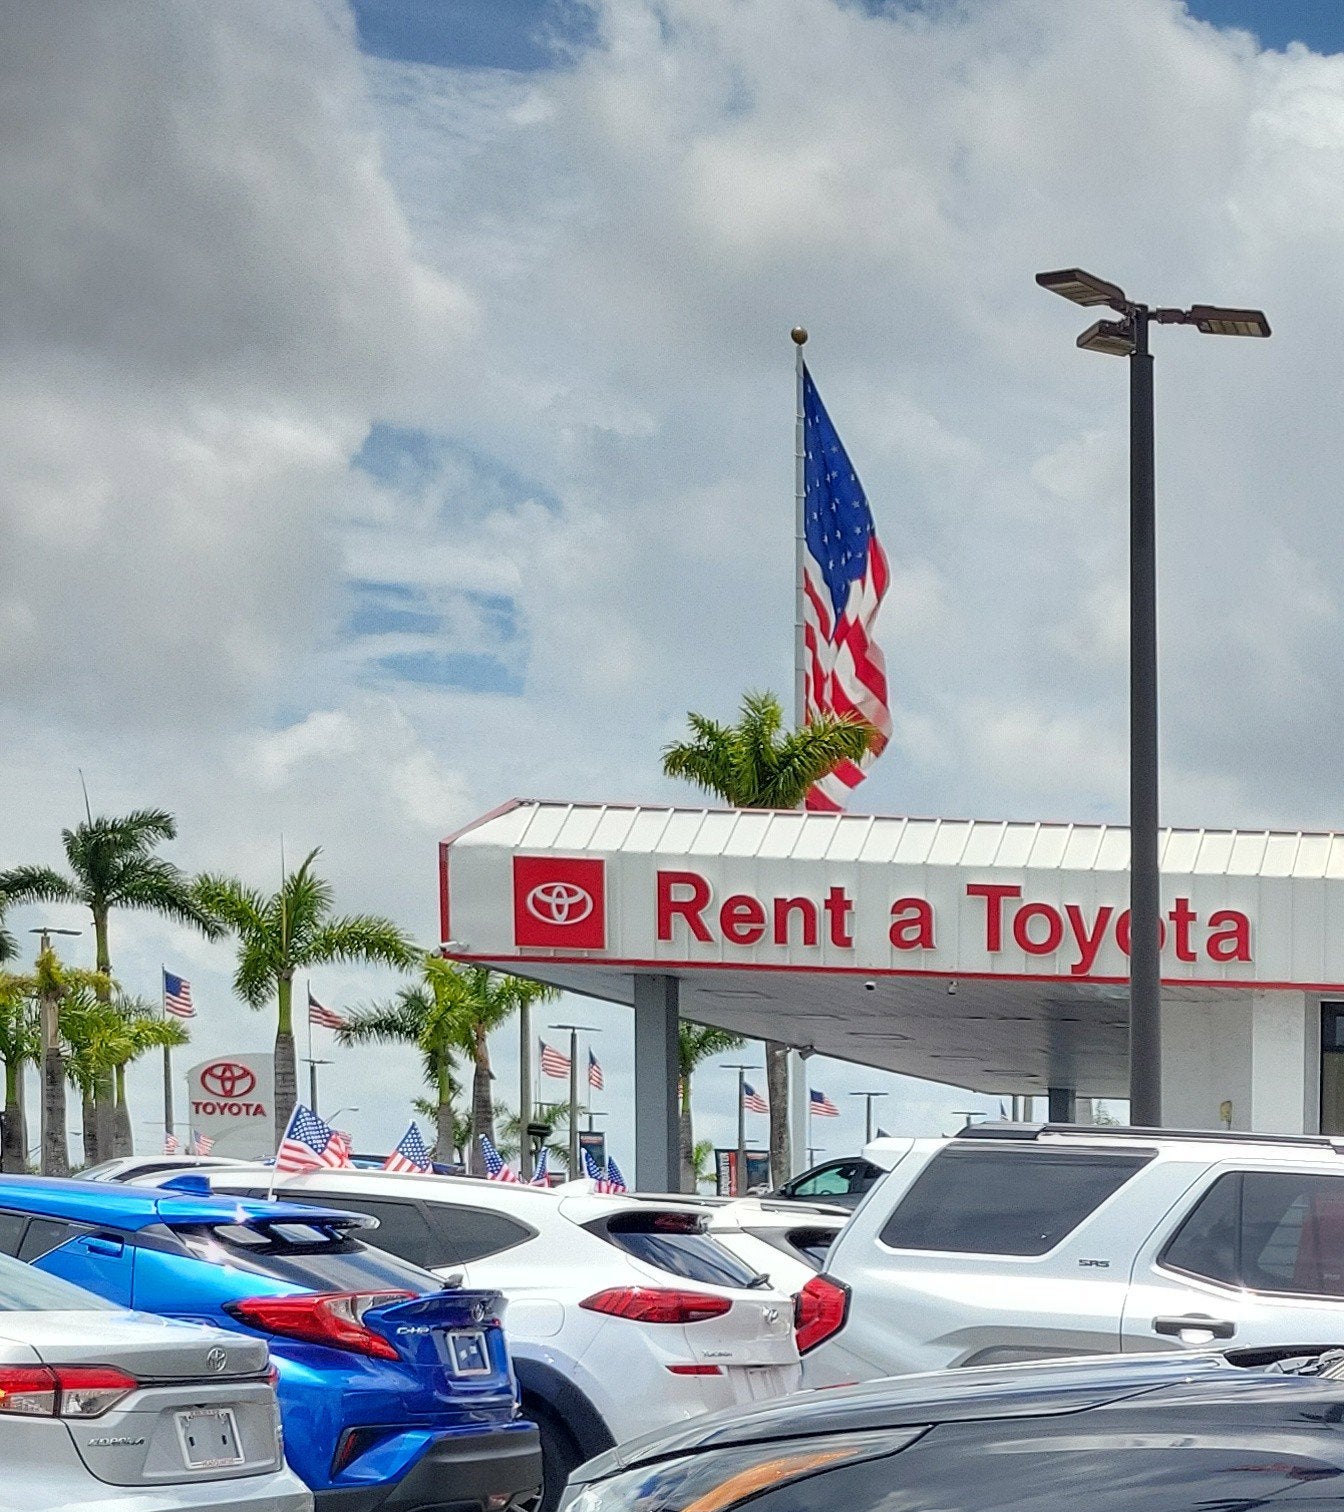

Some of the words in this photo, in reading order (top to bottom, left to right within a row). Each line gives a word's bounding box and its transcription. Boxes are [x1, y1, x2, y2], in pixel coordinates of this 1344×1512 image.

[657, 870, 853, 948] Rent
[889, 897, 936, 950] a
[191, 1101, 267, 1117] TOYOTA
